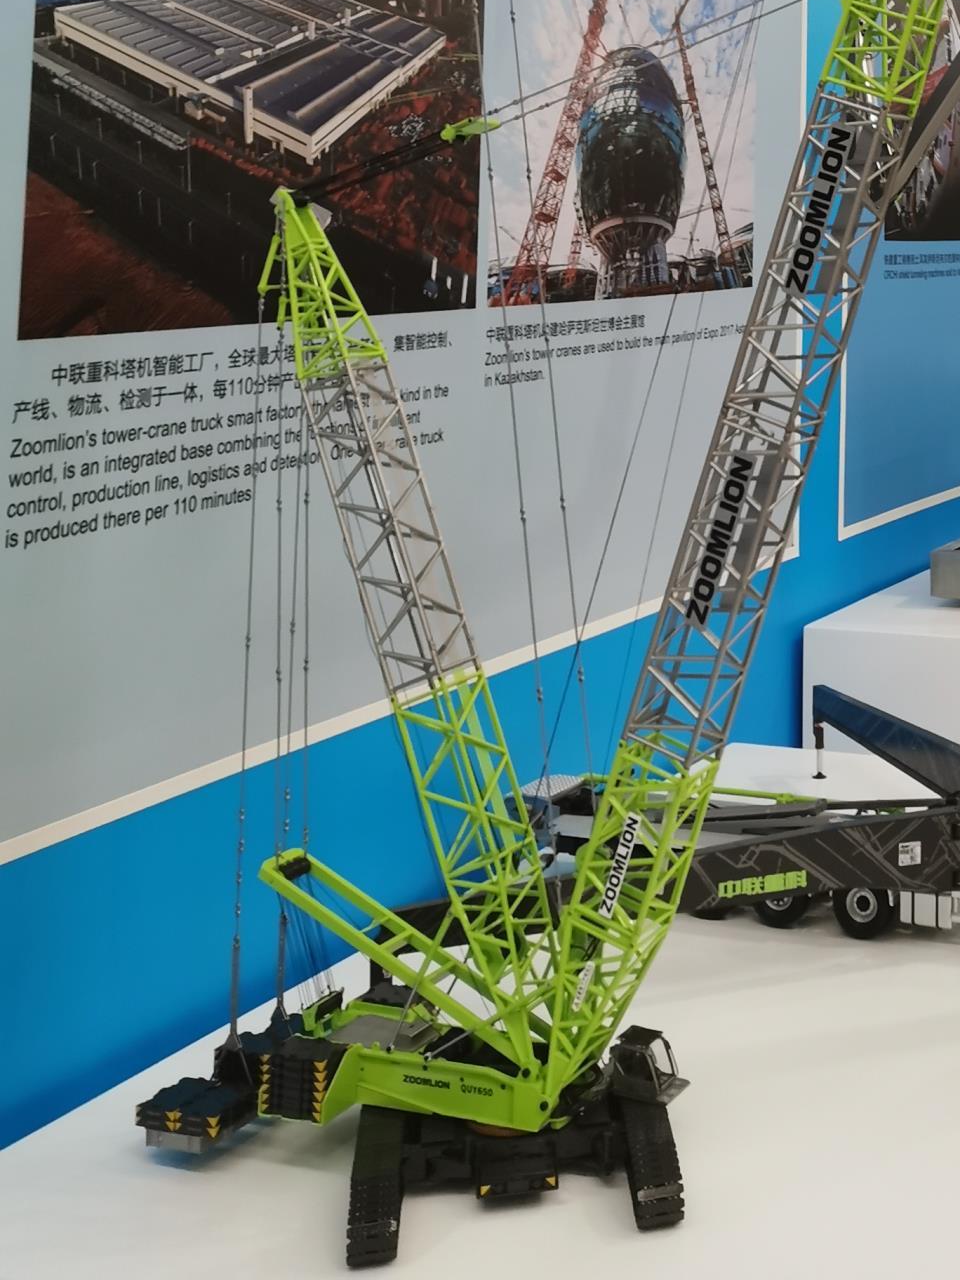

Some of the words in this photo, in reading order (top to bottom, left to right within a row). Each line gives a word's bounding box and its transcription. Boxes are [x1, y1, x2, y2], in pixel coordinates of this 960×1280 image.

[786, 127, 850, 293] ZOOMLION
[485, 349, 531, 366] Zoomlion's
[556, 345, 581, 358] cranes
[597, 340, 615, 353] used
[9, 465, 57, 488] world,
[63, 461, 76, 480] is
[80, 461, 99, 478] an
[104, 446, 177, 474] integrated
[181, 442, 213, 461] base
[217, 430, 281, 455] combining
[284, 426, 301, 445] the
[10, 429, 97, 458] Zoomlion's
[102, 418, 187, 445] tower-crane
[191, 413, 223, 432] truck
[227, 407, 261, 428] smart
[423, 386, 432, 400] in
[434, 383, 449, 398] the
[7, 492, 66, 519] control,
[72, 480, 150, 511] production
[154, 472, 183, 492] line,
[187, 462, 241, 487] logistics
[243, 456, 267, 476] and
[420, 428, 445, 446] truck
[5, 529, 19, 548] is
[24, 513, 98, 549] produced
[103, 510, 141, 530] there
[145, 504, 170, 526] per
[174, 495, 198, 515] 110
[201, 488, 253, 510] minutes
[687, 456, 752, 625] ZOOMLION
[601, 816, 639, 914] ZOOMLION
[403, 1074, 450, 1089] ZOOMLION
